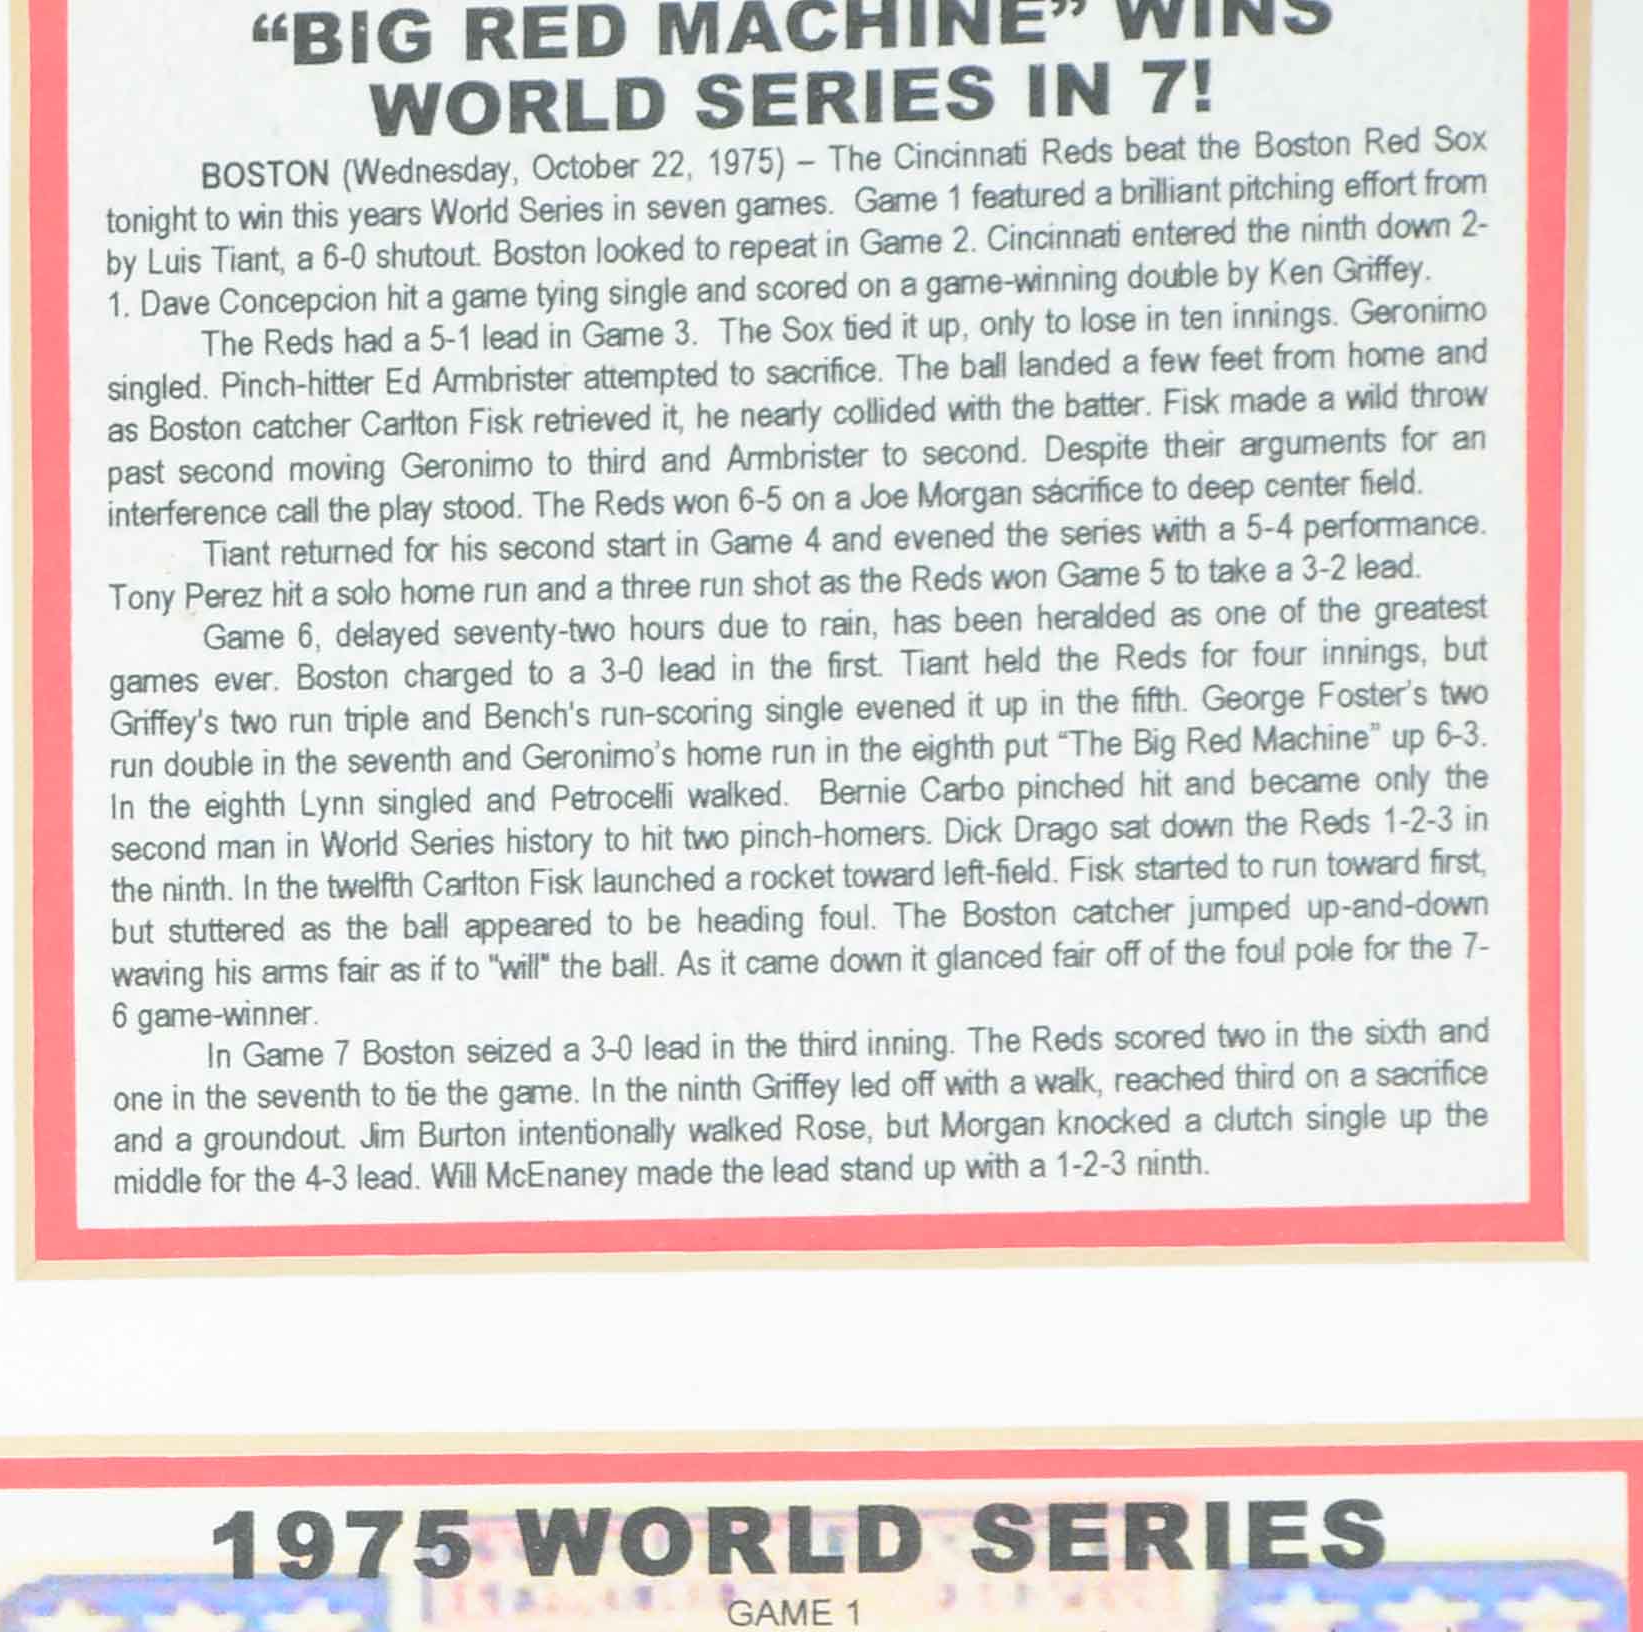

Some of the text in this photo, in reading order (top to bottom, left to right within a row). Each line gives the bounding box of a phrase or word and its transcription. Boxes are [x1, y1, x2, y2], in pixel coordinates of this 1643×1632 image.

[465, 3, 627, 62] RED
[1114, 0, 1333, 41] WINS
[368, 58, 1211, 138] WORLD SERIES IN 7!
[201, 159, 329, 190] BOSTON
[343, 154, 518, 193] (Wednesday,
[532, 151, 640, 181] October
[652, 149, 692, 181] 22,
[709, 146, 785, 183] 1975)
[828, 143, 882, 172] The
[894, 138, 1027, 171] Cincinnati
[1042, 136, 1113, 166] Reds
[1125, 135, 1187, 163] beat
[1197, 132, 1240, 161] the
[1255, 130, 1351, 159] Boston
[1365, 126, 1420, 155] Red
[1434, 124, 1487, 153] Sox
[108, 254, 1430, 321] 1. Dave Concepcion hit a game tying single and scored on a game-winning double by Ken Griffey.
[114, 1147, 1202, 1195] middle for the 4-3 lead. Will McEnaney made the lead stand up with a 1-2-3 ninth.
[212, 1498, 1386, 1582] 1975 WORLD SERIES
[727, 1598, 833, 1627] GAME
[847, 1598, 859, 1626] 1
